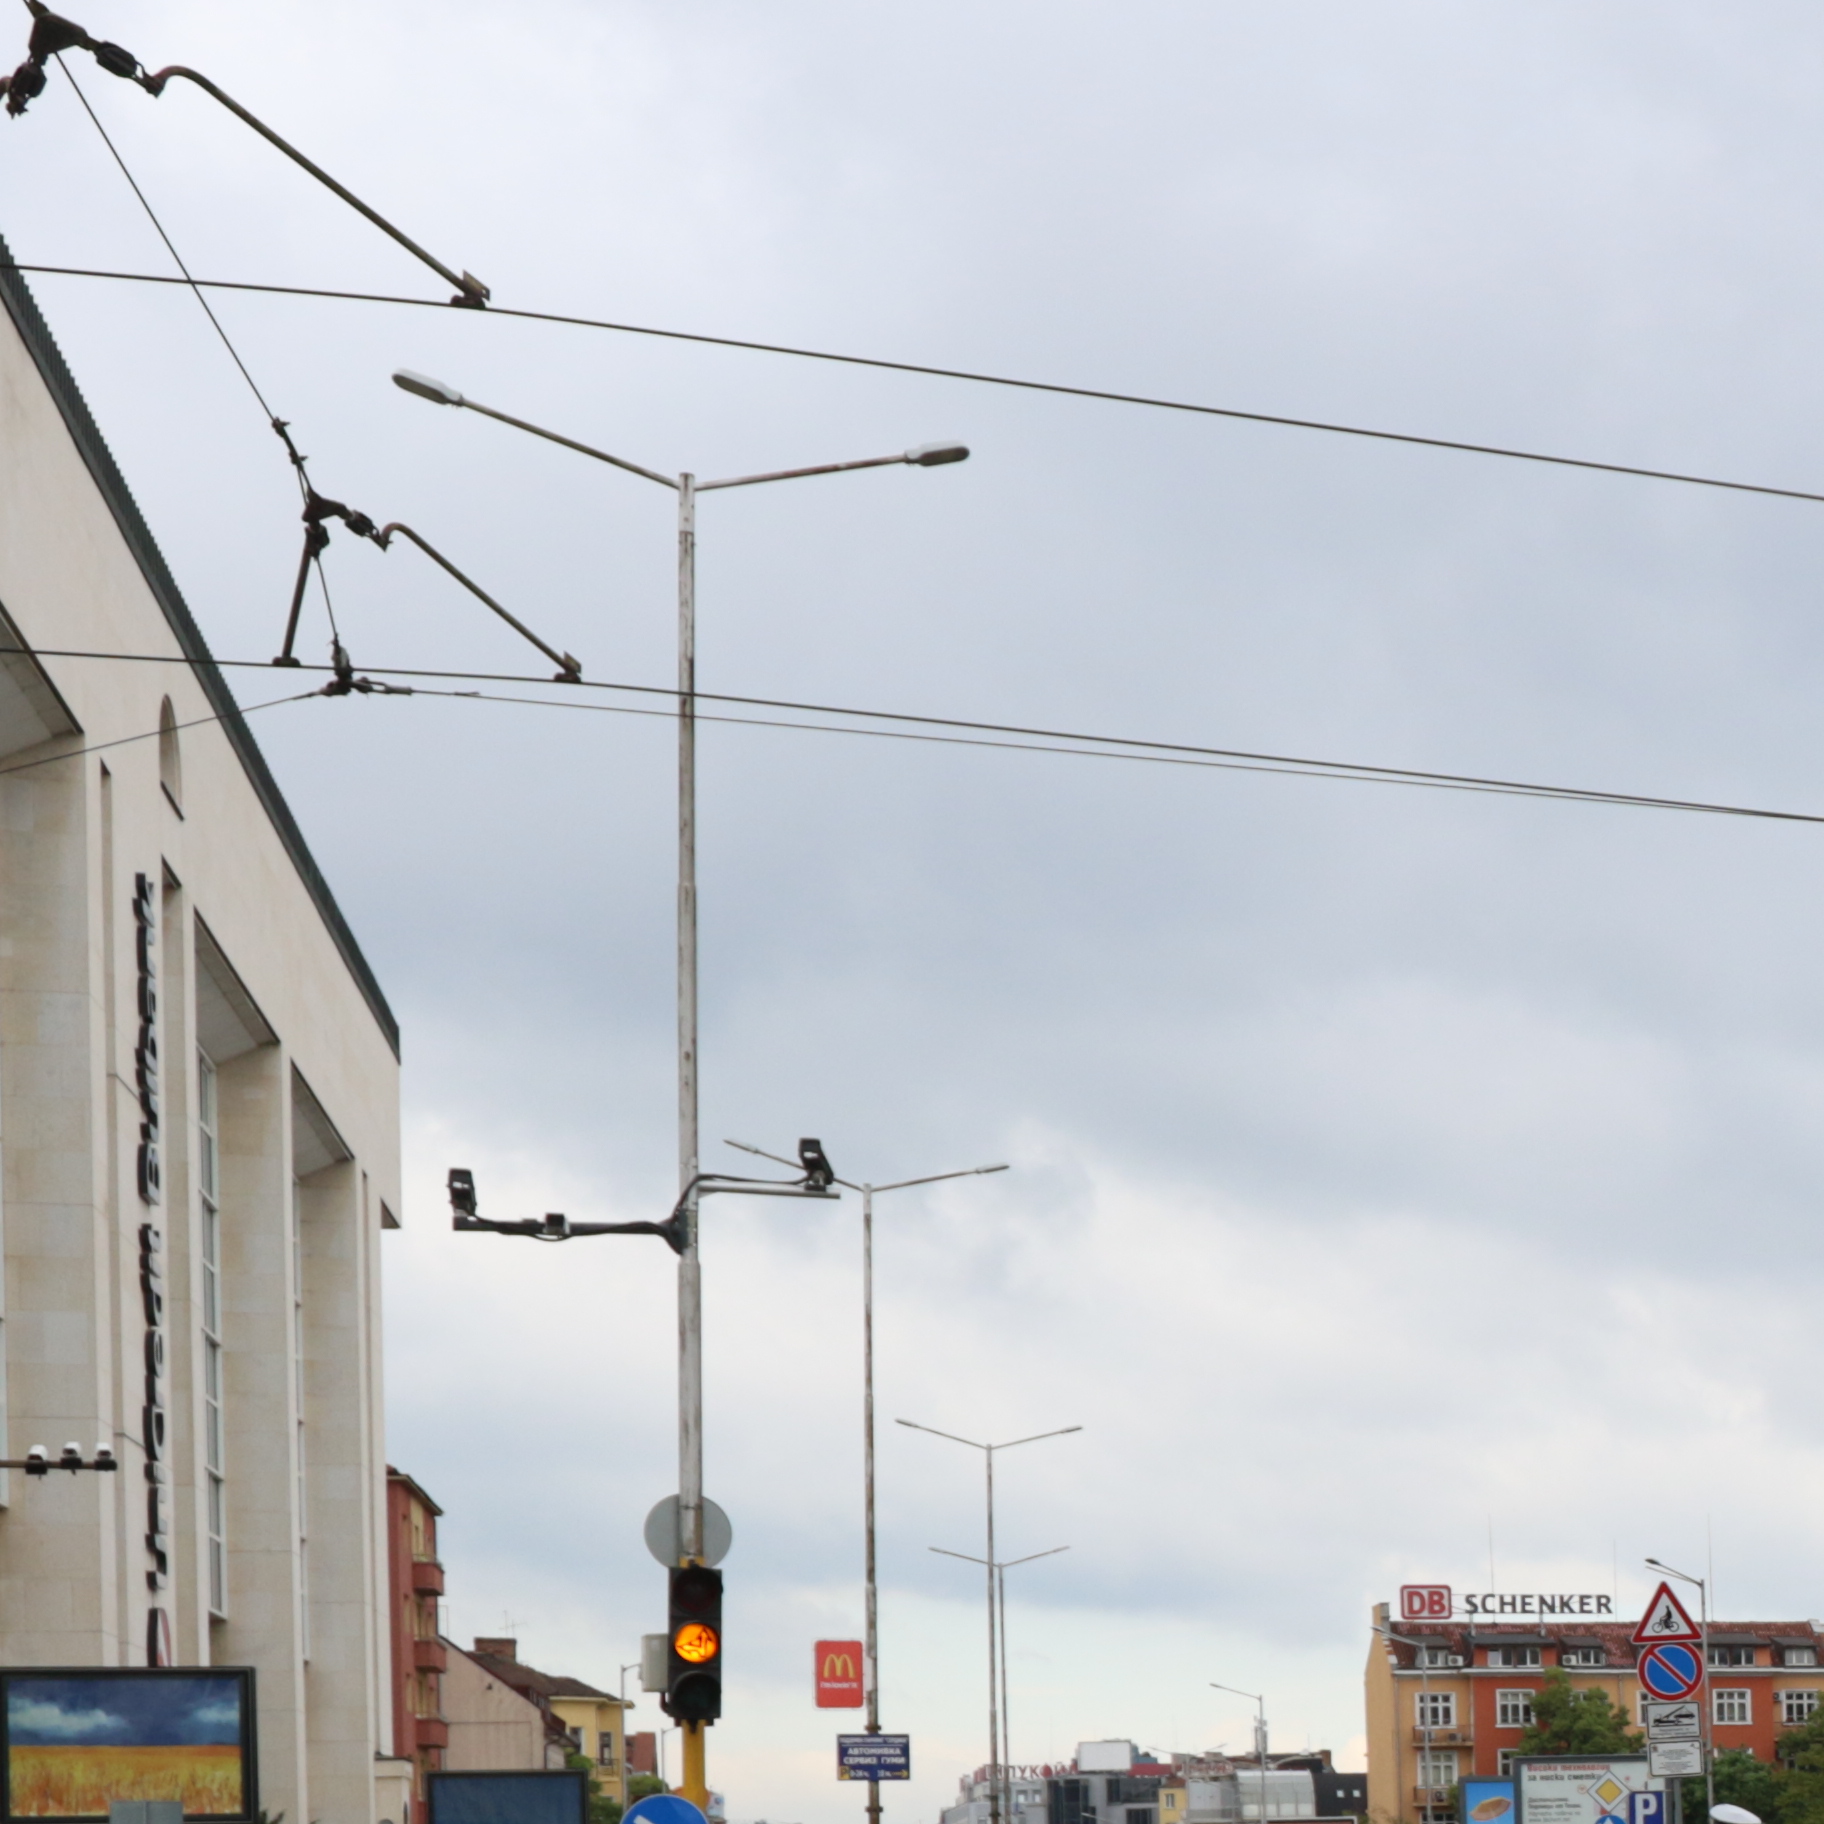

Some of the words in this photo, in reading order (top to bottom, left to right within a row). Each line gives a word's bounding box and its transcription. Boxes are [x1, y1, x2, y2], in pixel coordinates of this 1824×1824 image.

[1406, 1590, 1447, 1615] DB
[1465, 1593, 1613, 1614] SCHENKER
[847, 1747, 901, 1755] АВТОМИВКА
[843, 1756, 878, 1765] СЕРВИЗ
[881, 1756, 906, 1765] ГУМИ
